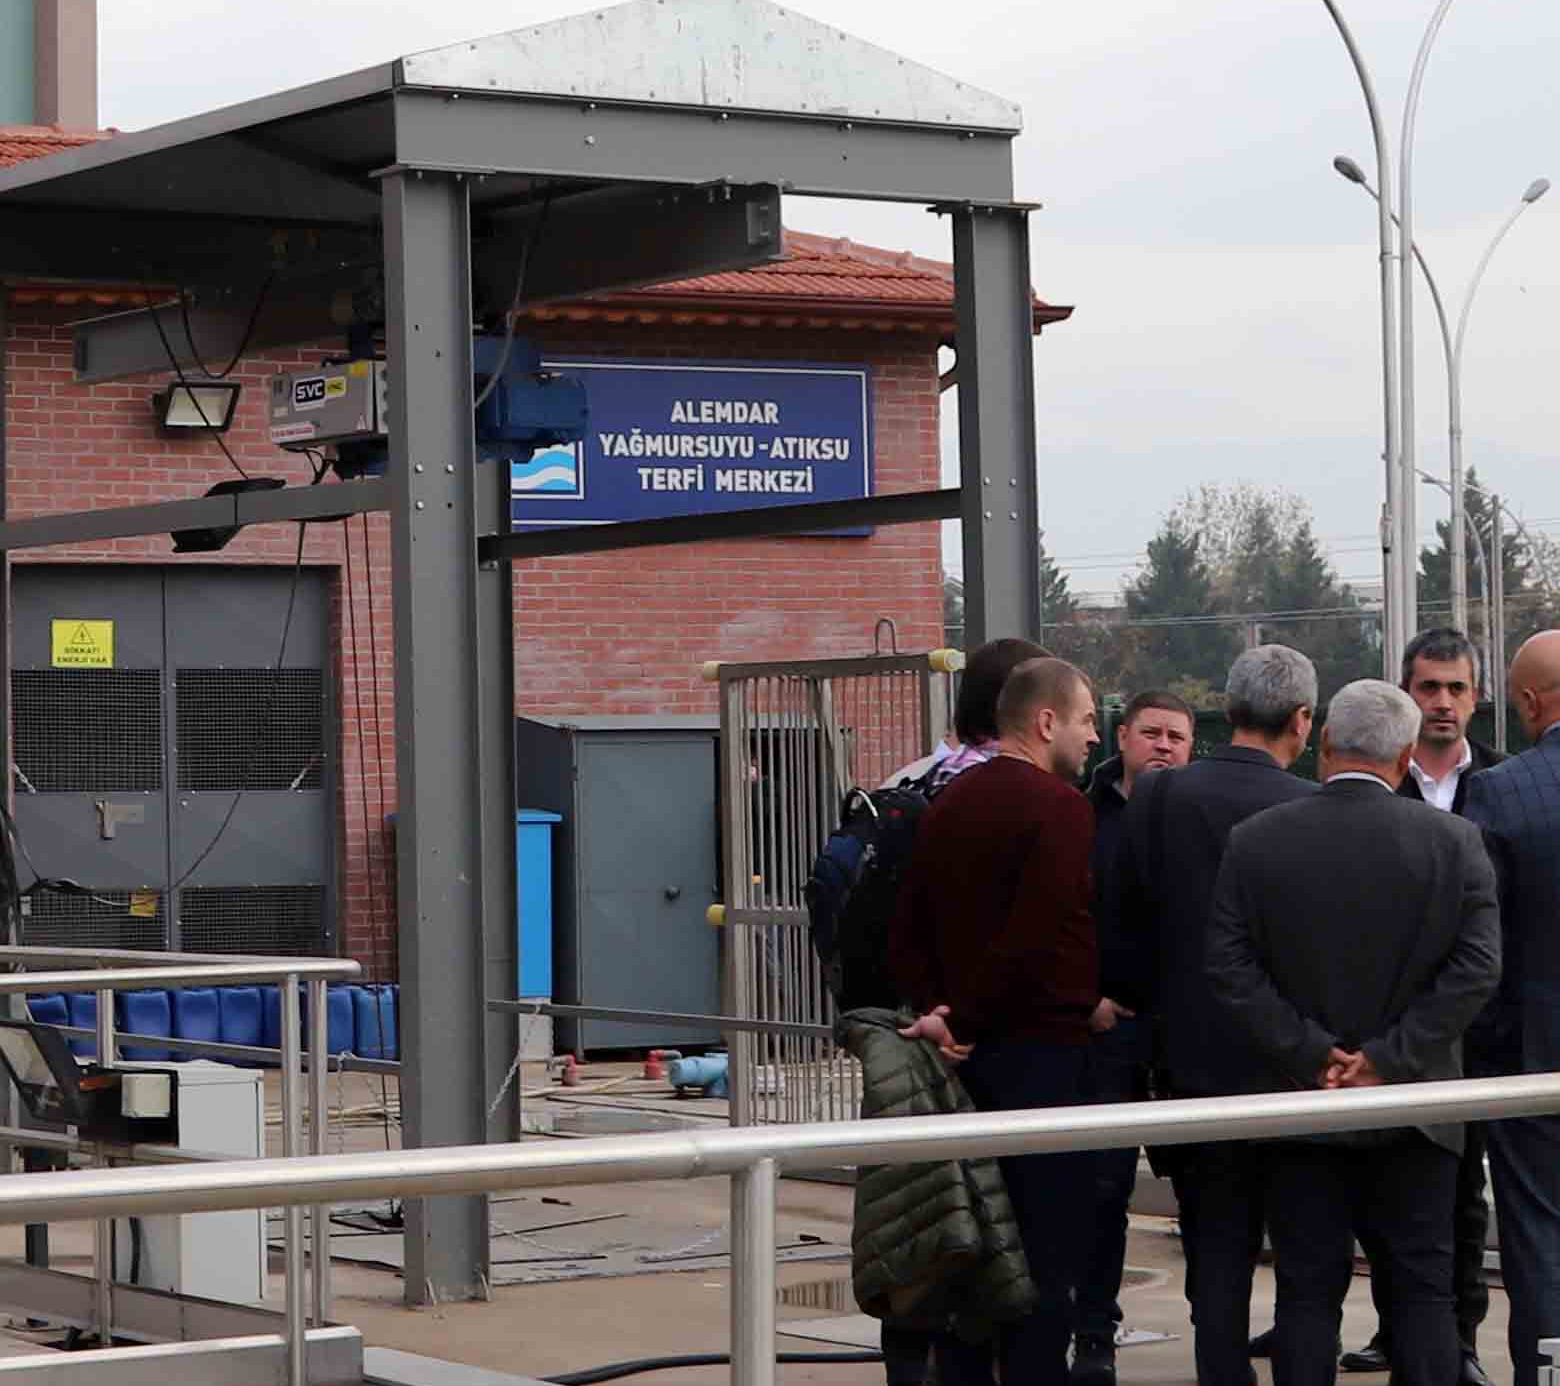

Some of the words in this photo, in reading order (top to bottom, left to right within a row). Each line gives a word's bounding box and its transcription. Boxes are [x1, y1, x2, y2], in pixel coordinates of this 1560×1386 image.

[296, 383, 323, 400] SVC
[670, 400, 780, 425] ALEMDAR
[599, 427, 754, 458] YAĞMURSUYU
[637, 463, 704, 492] TERFİ
[714, 465, 814, 494] MERKEZİ
